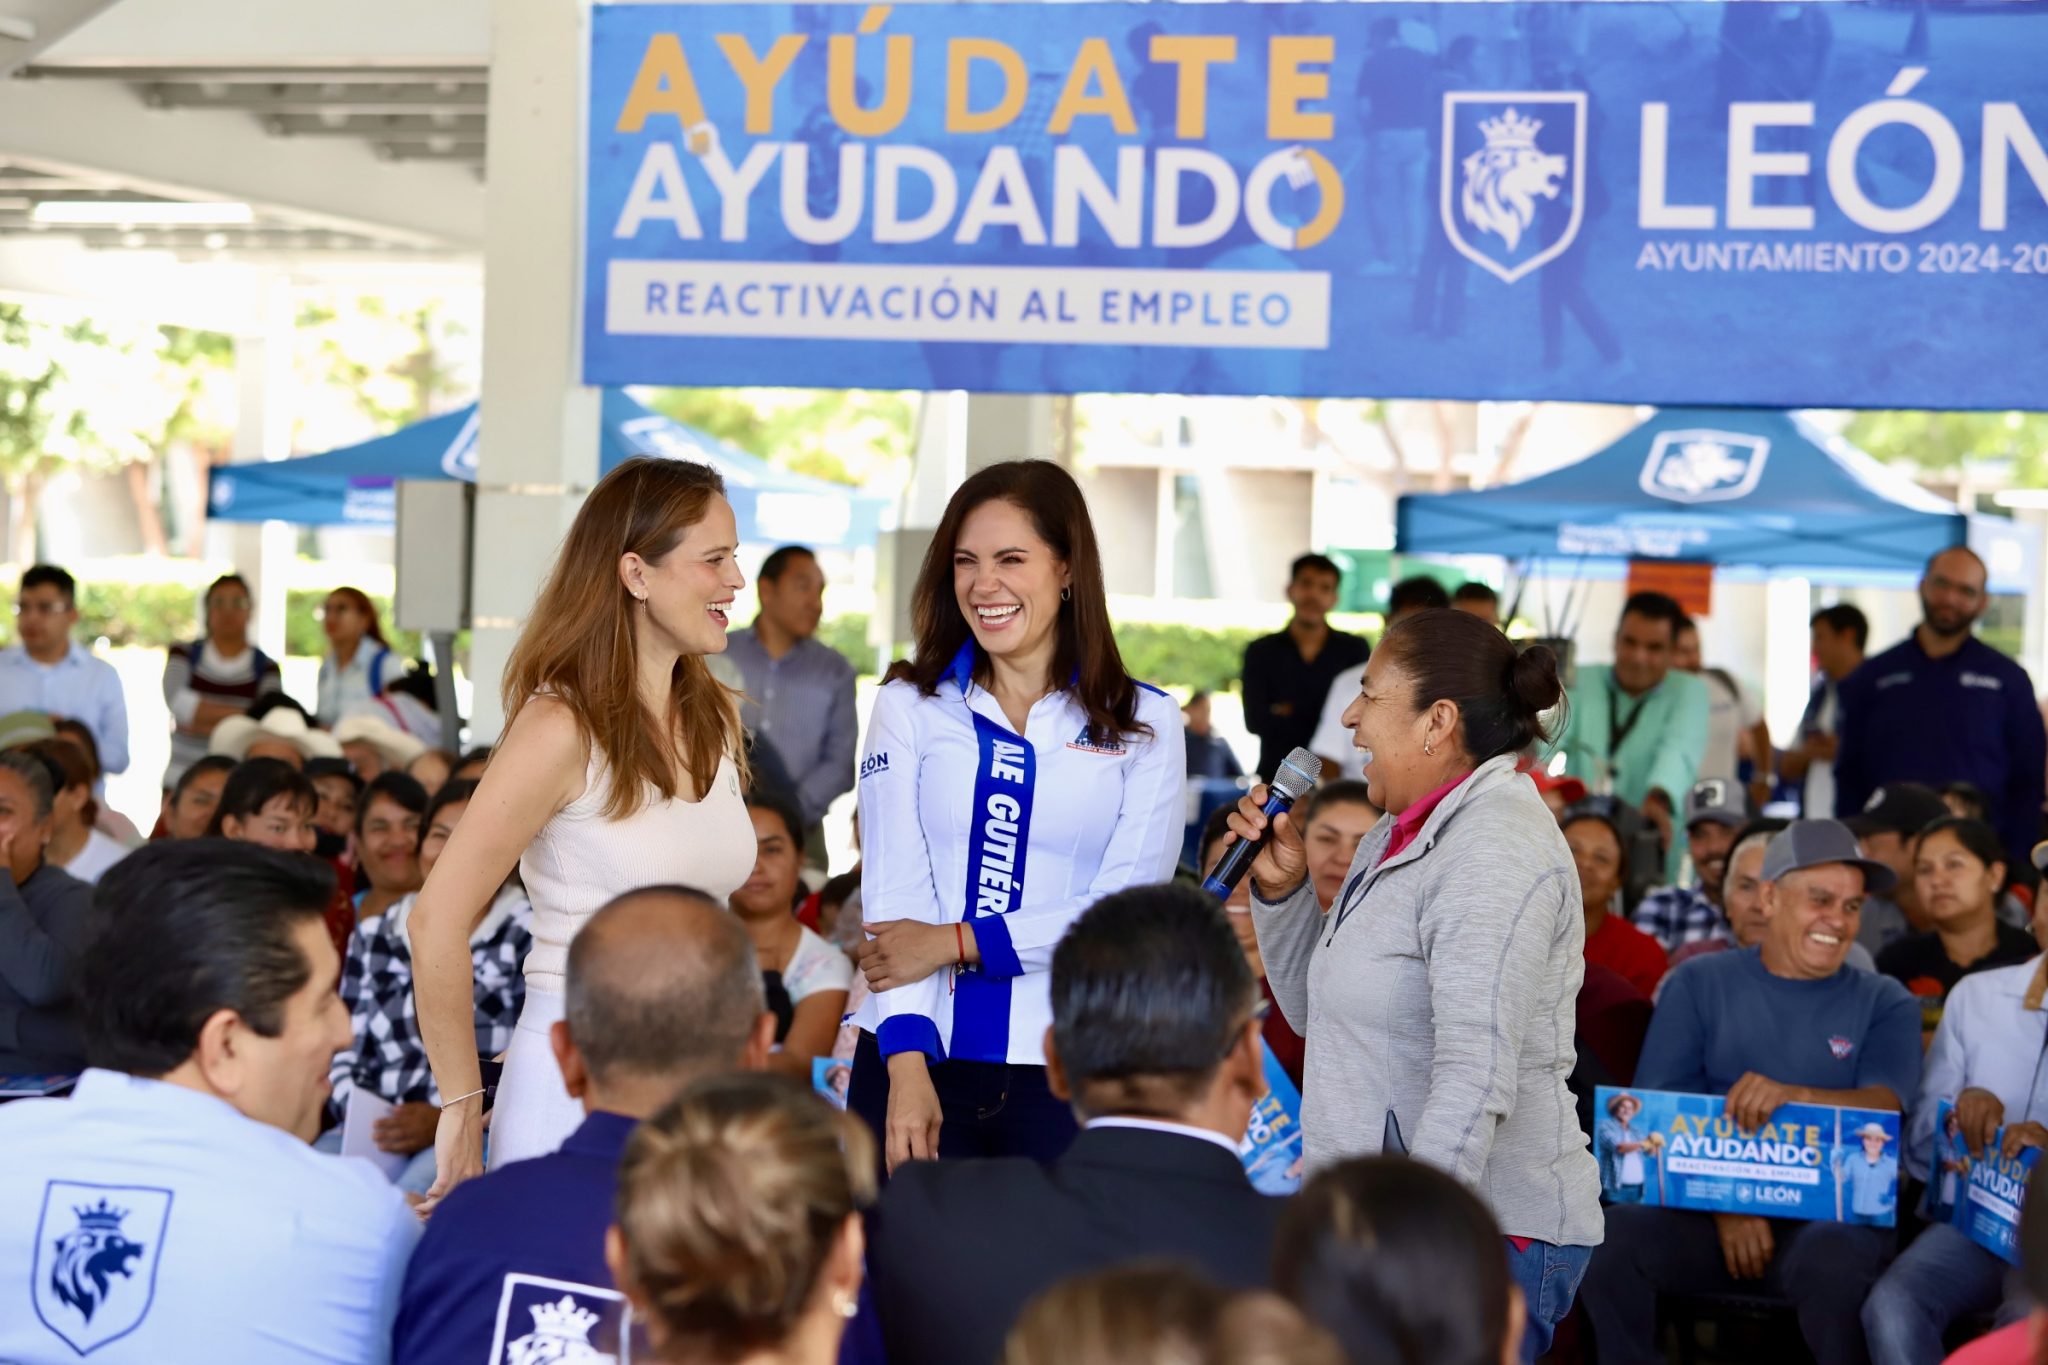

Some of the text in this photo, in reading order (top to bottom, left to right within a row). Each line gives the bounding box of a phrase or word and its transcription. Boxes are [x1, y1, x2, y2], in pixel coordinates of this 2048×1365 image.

[613, 5, 1336, 139] AYÚDATE
[612, 141, 1345, 251] AYUDANDO
[1636, 242, 1910, 273] AYUNTAMIENTO
[645, 278, 1292, 328] REACTIVACIÓN AL EMPLEO
[1669, 1134, 1823, 1167] AYUDANDO
[1755, 1184, 1802, 1204] LEÓN
